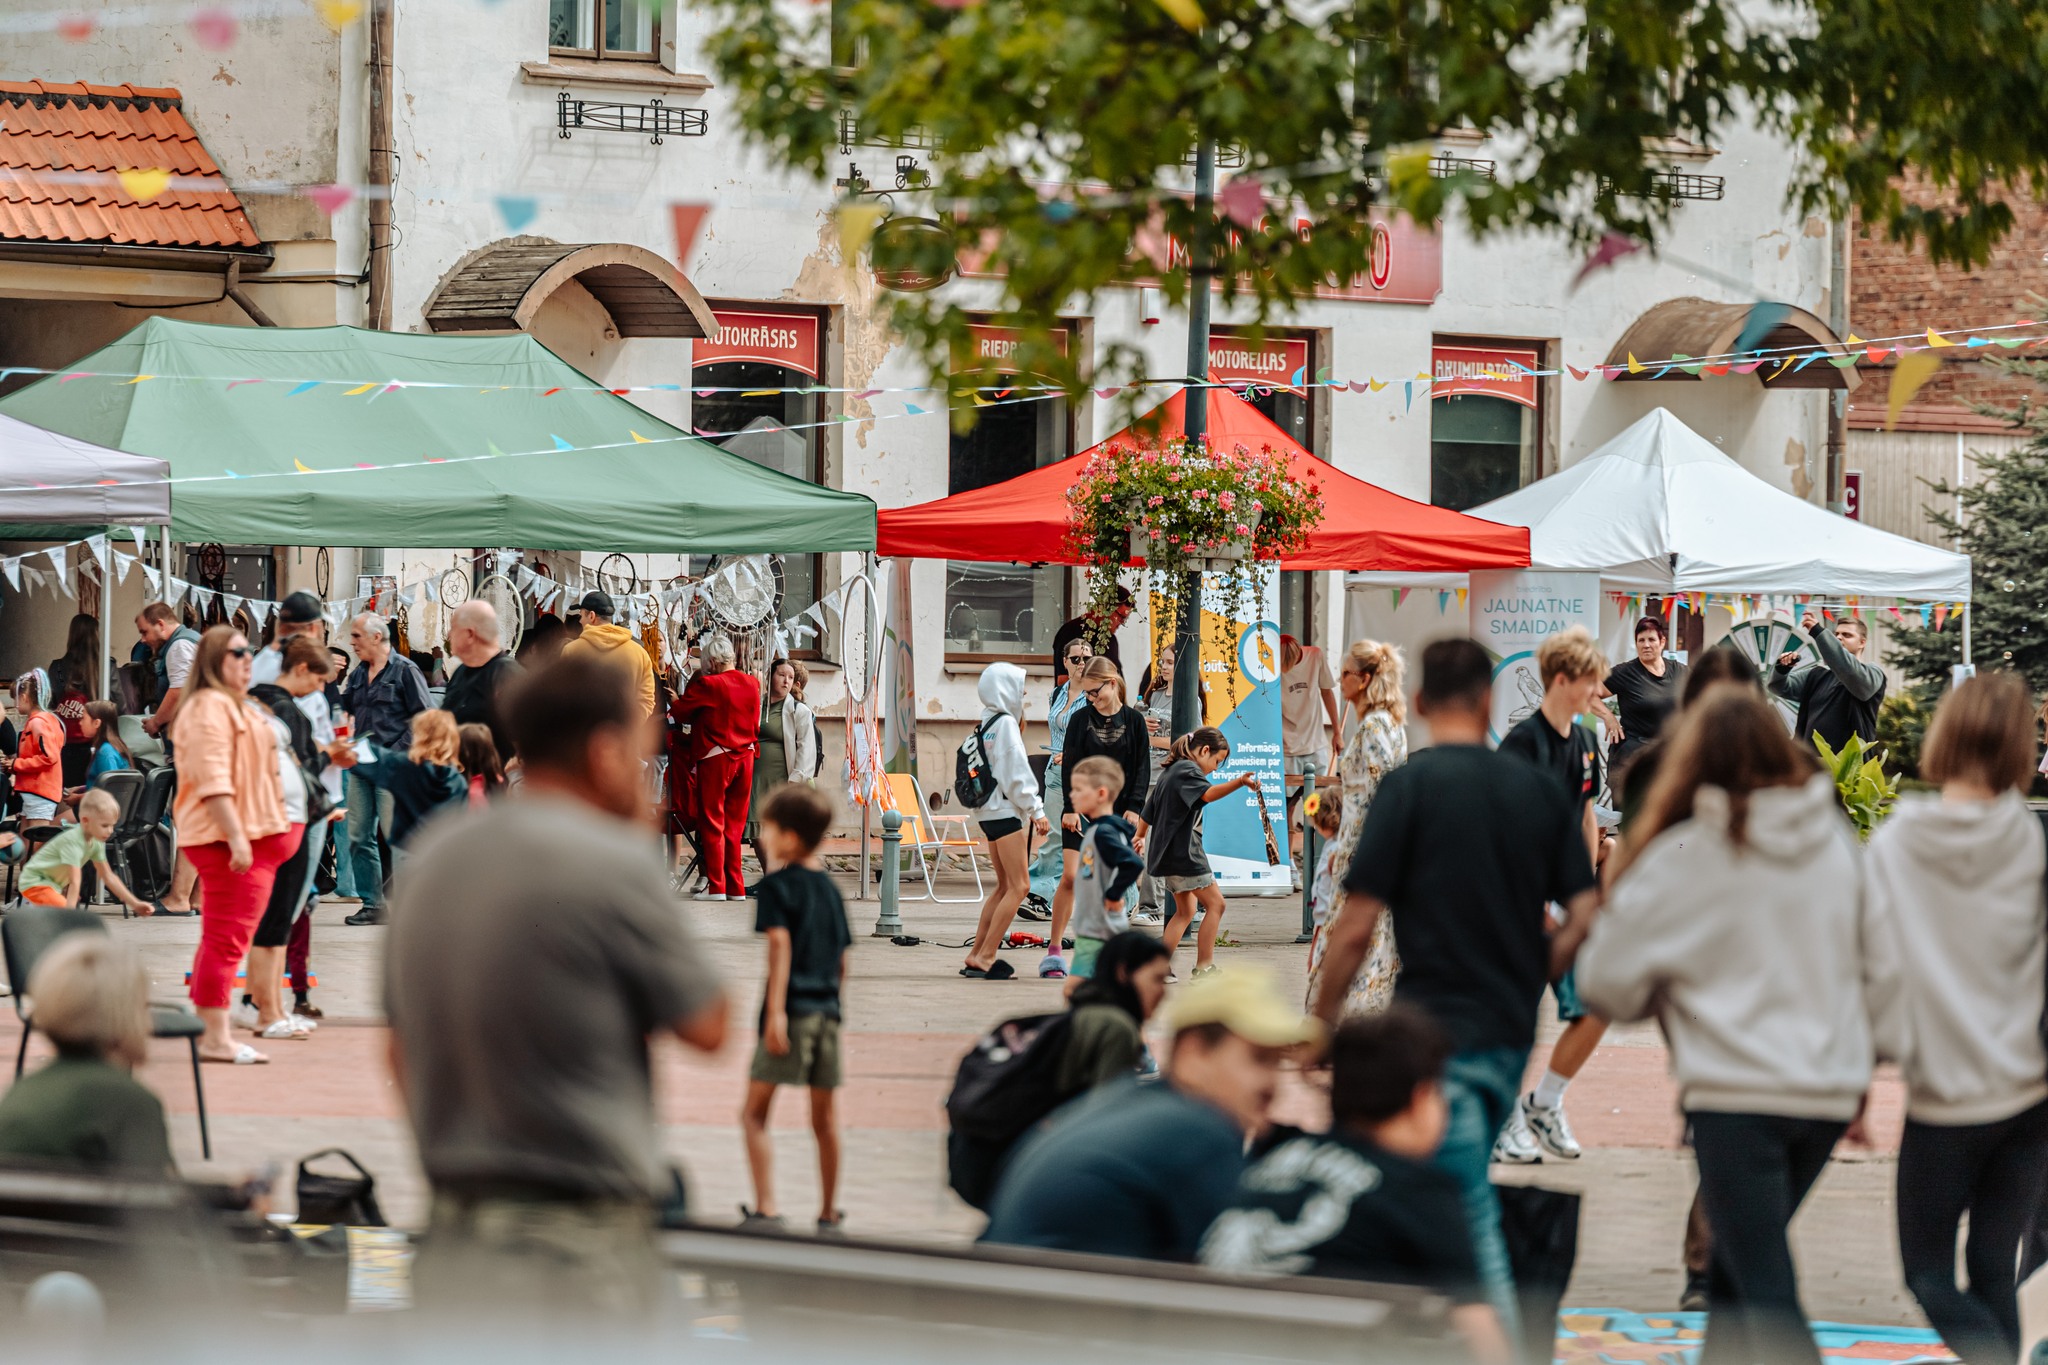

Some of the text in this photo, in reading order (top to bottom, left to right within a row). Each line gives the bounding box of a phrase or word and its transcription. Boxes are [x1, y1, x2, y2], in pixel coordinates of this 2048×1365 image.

[704, 326, 798, 349] UTOKRĀSAS
[1207, 349, 1287, 375] MOTOREĻĻAS
[1483, 598, 1584, 614] JAUNATNE
[1237, 742, 1280, 755] Informācija
[1227, 756, 1281, 769] jauniešiem par
